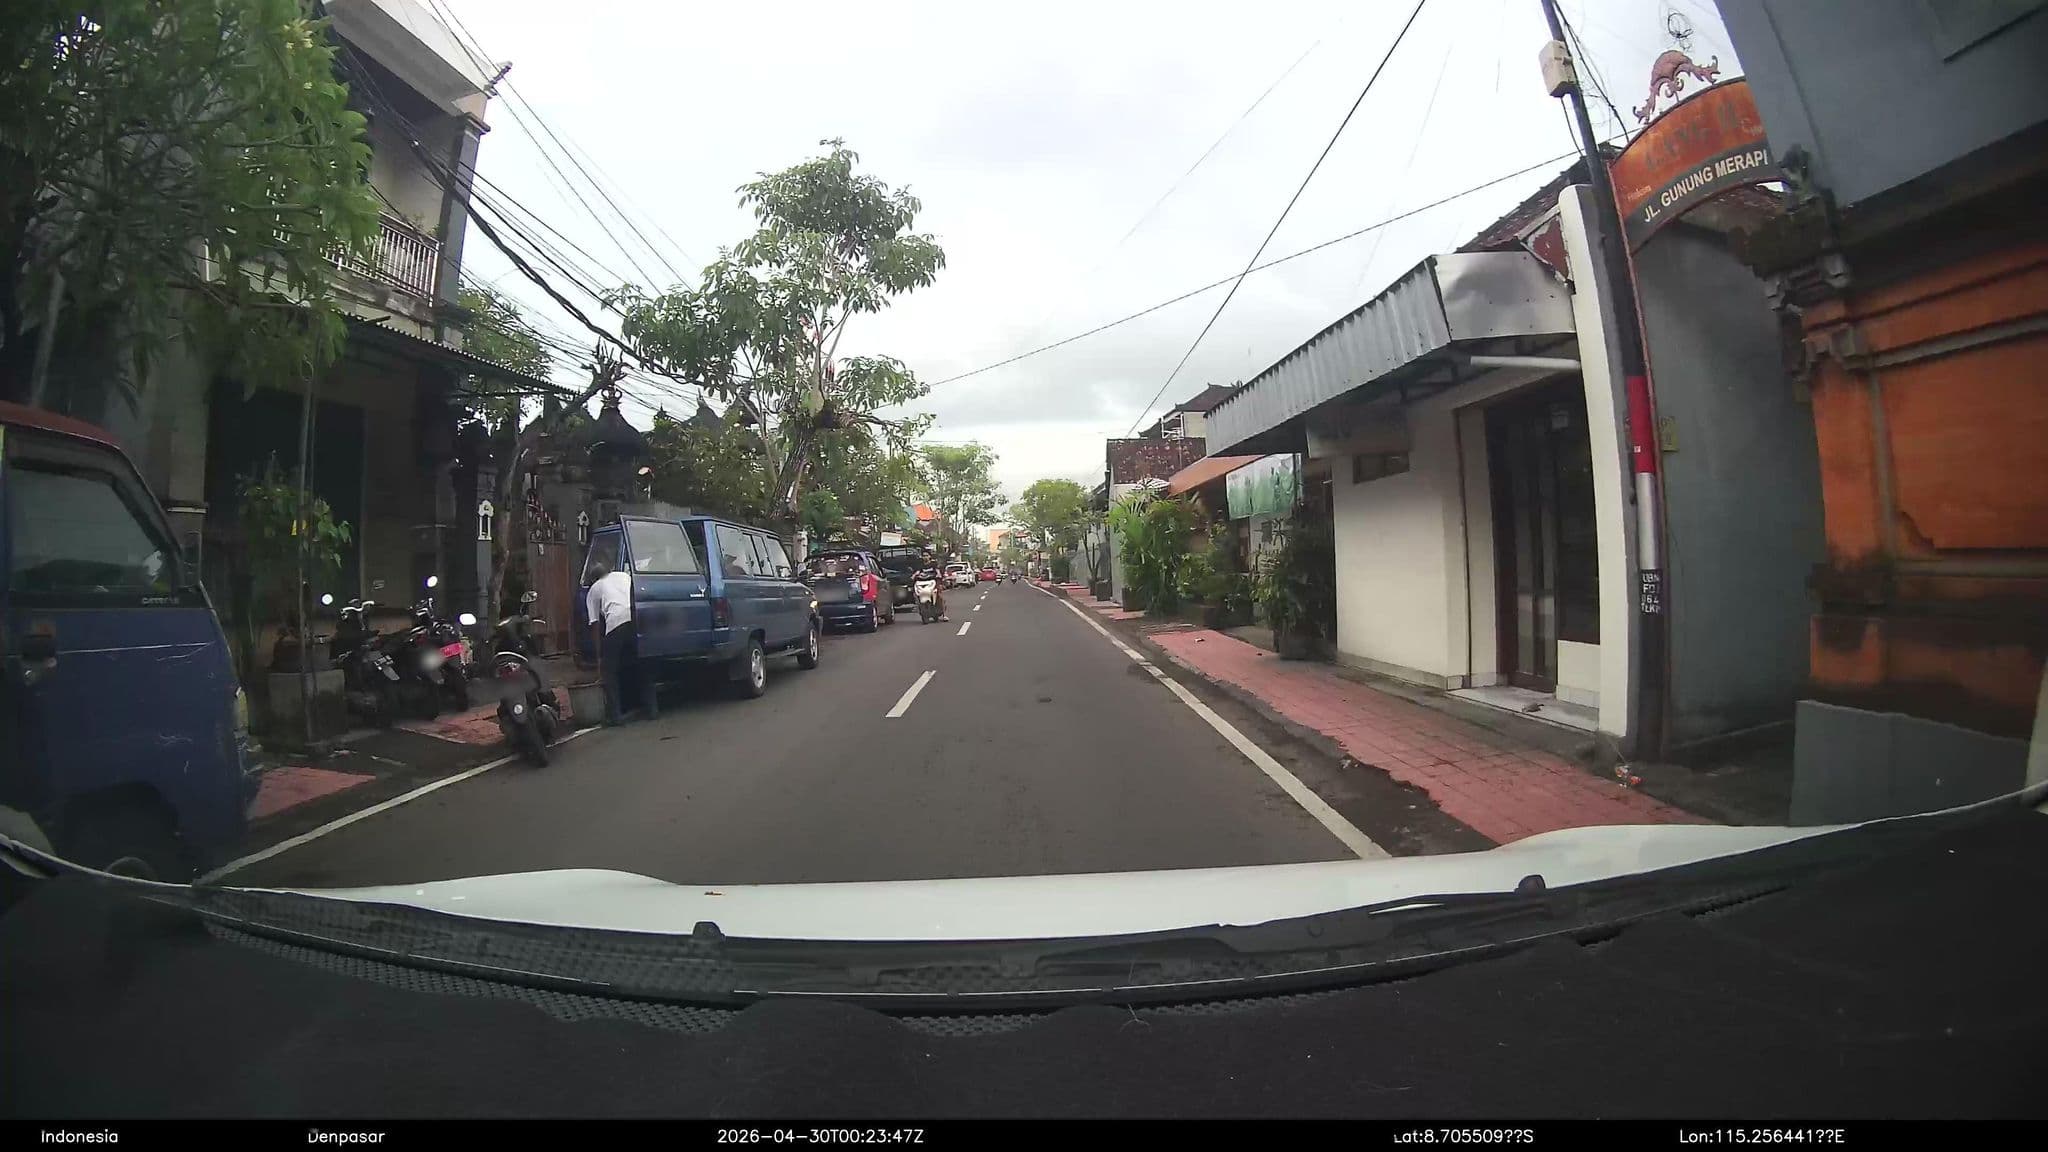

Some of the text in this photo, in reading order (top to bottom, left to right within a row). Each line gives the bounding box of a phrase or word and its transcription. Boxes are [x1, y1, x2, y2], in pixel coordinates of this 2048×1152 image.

[1643, 205, 1661, 223] JL.
[1660, 166, 1714, 207] GUNUNG
[1714, 149, 1769, 179] MERAPI
